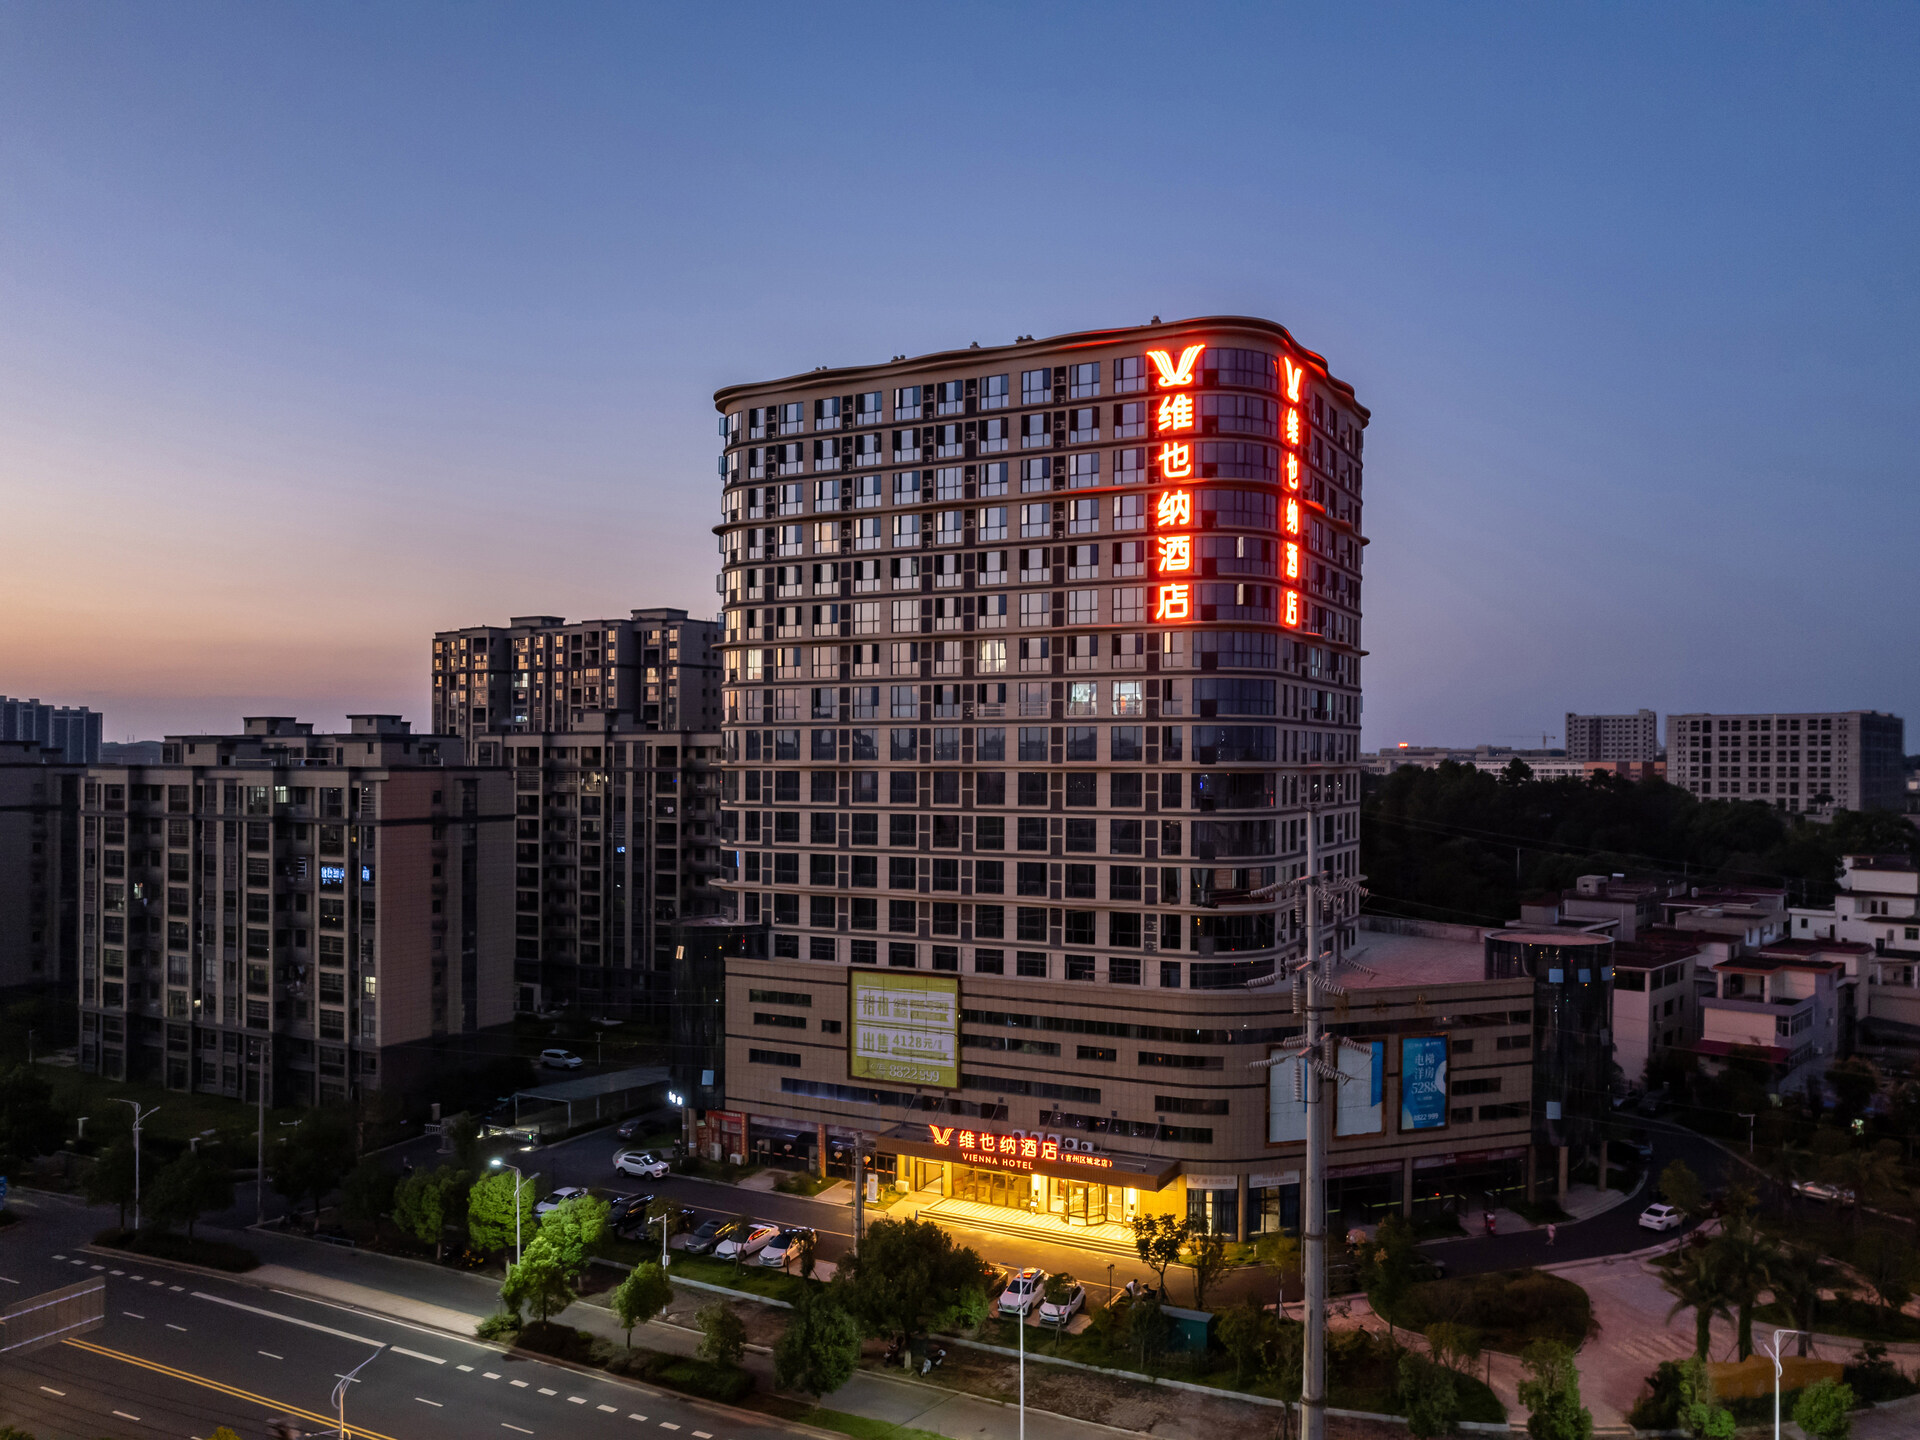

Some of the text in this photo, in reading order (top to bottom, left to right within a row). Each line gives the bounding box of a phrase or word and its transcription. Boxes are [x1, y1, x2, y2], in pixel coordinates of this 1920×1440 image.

[1156, 393, 1193, 619] 维也纳酒店
[1286, 407, 1299, 625] 维也纳酒店
[863, 994, 889, 1016] 招租
[863, 1032, 889, 1054] 出售
[1411, 1081, 1437, 1094] 5288
[958, 1130, 1059, 1161] 维也纳酒店
[962, 1152, 1034, 1170] VIENNA HOTEL
